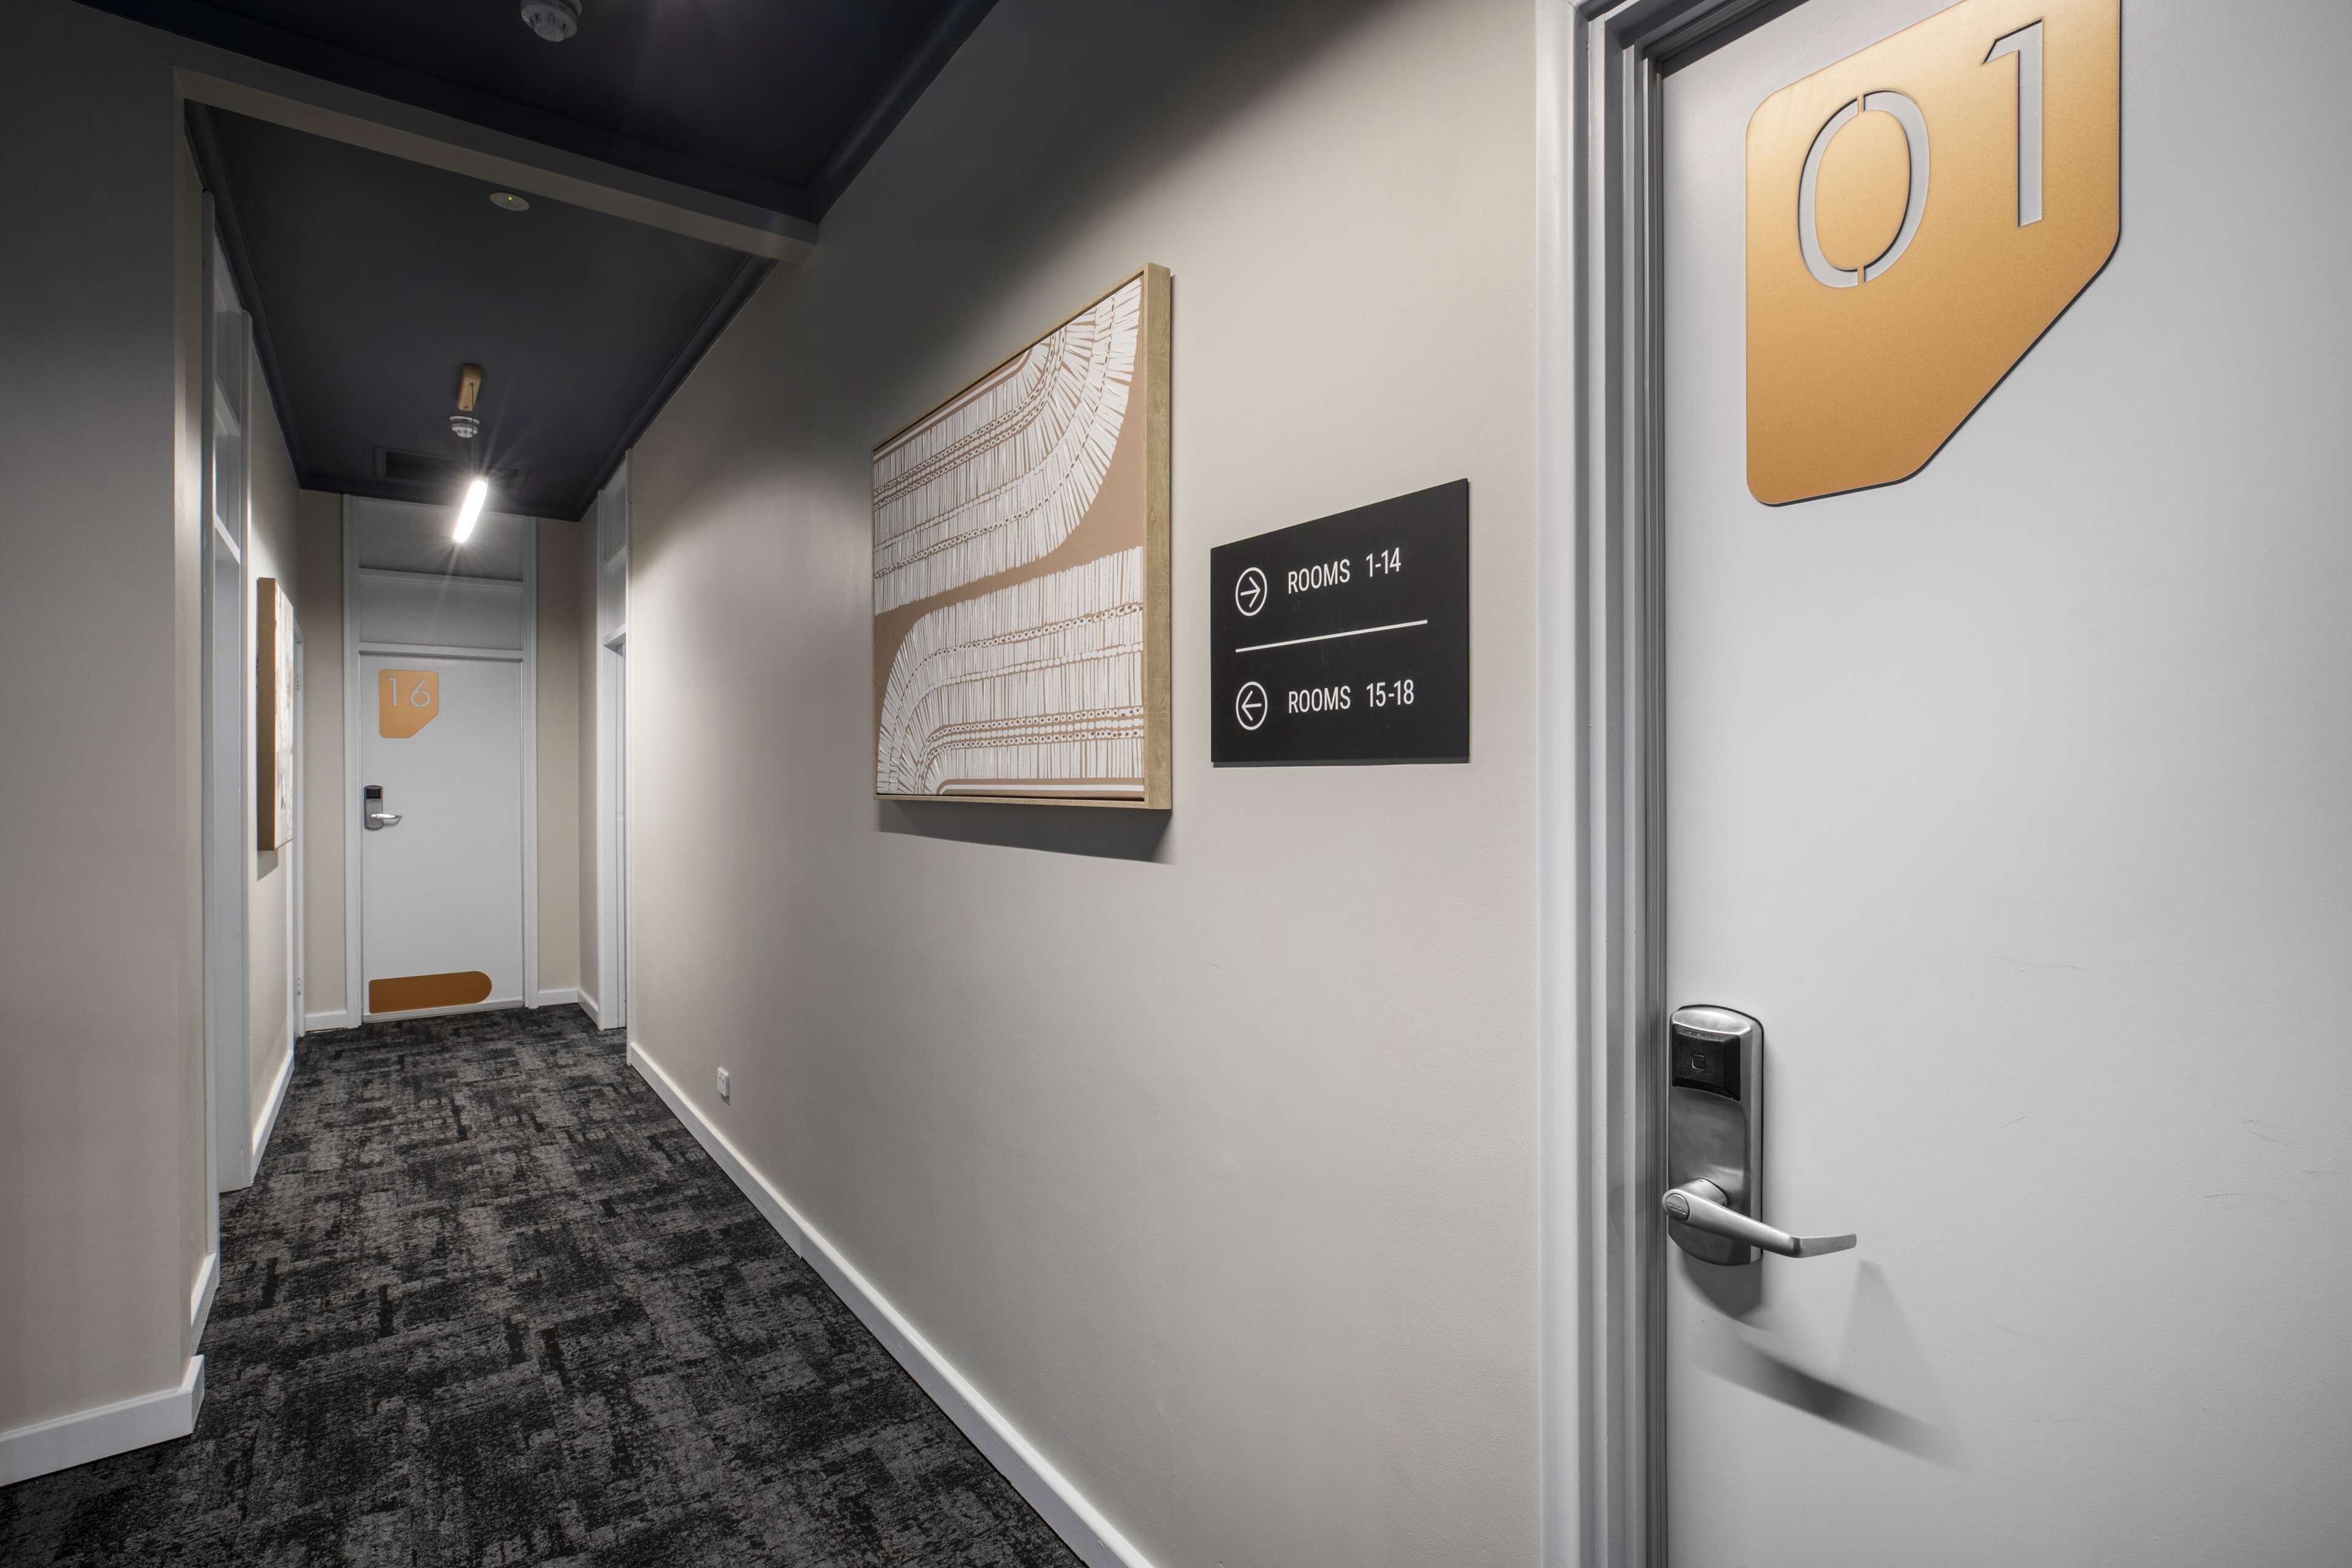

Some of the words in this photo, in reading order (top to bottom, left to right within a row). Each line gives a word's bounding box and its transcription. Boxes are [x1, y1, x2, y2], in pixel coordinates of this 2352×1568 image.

[1797, 17, 2043, 289] 01
[1287, 559, 1351, 594] ROOMS
[1366, 547, 1401, 578] 1-14
[386, 676, 431, 707] 16
[1288, 685, 1351, 714] ROOMS
[1366, 679, 1415, 707] 15-18
